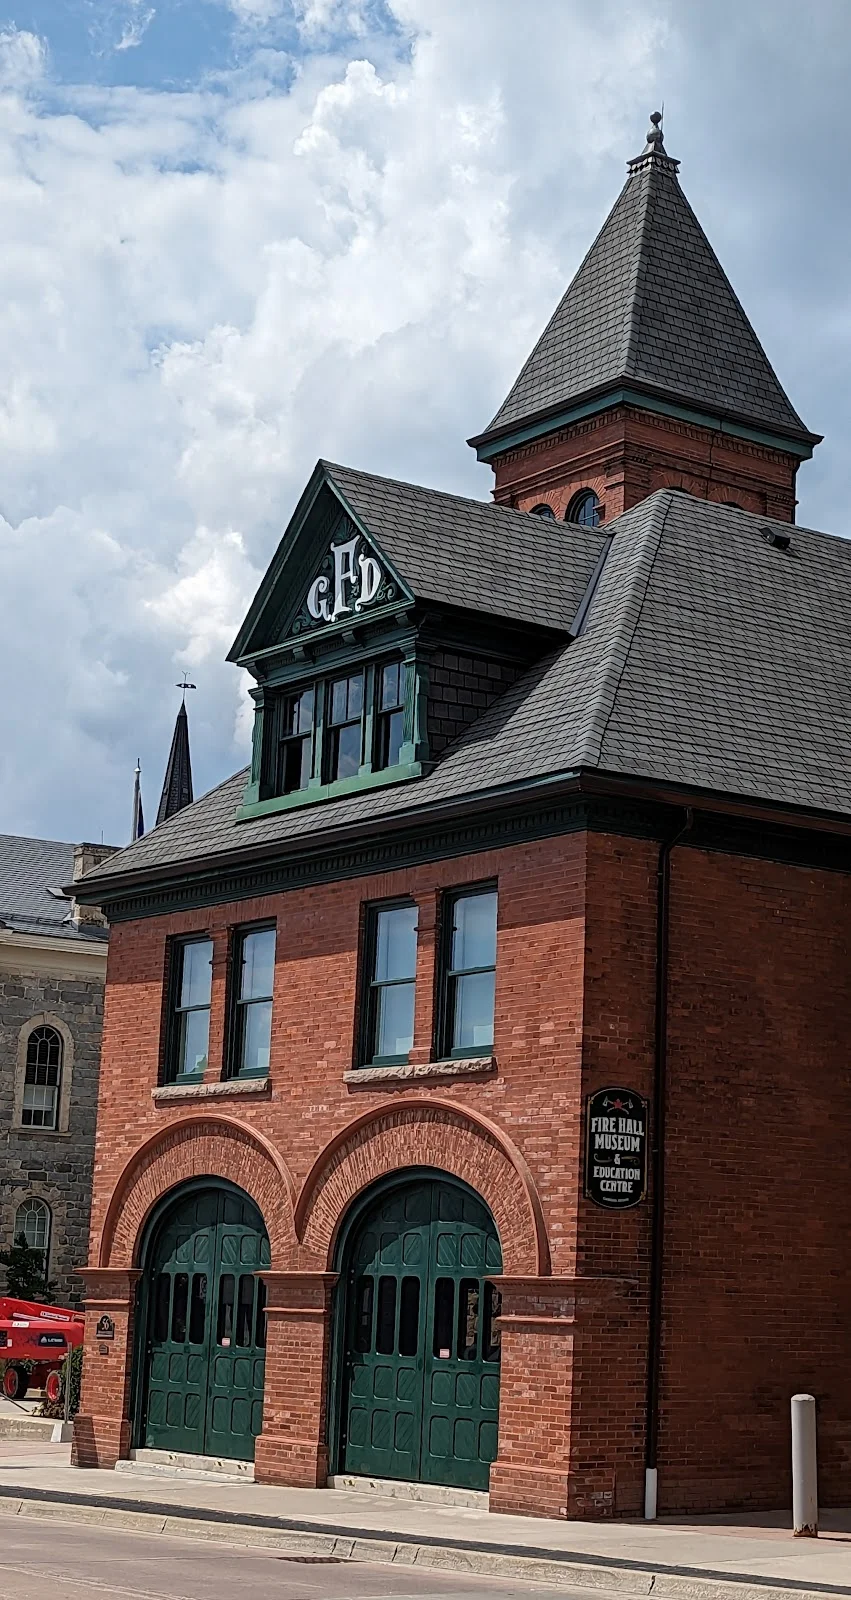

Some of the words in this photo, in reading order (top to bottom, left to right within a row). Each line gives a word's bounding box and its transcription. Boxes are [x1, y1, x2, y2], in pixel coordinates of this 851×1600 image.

[306, 535, 381, 622] GFD
[591, 1117, 616, 1133] FIRE
[618, 1117, 644, 1136] HALL
[594, 1134, 640, 1152] MUSEUM
[613, 1153, 621, 1165] &
[593, 1166, 641, 1180] EDUCATION
[600, 1180, 633, 1193] CENTRE
